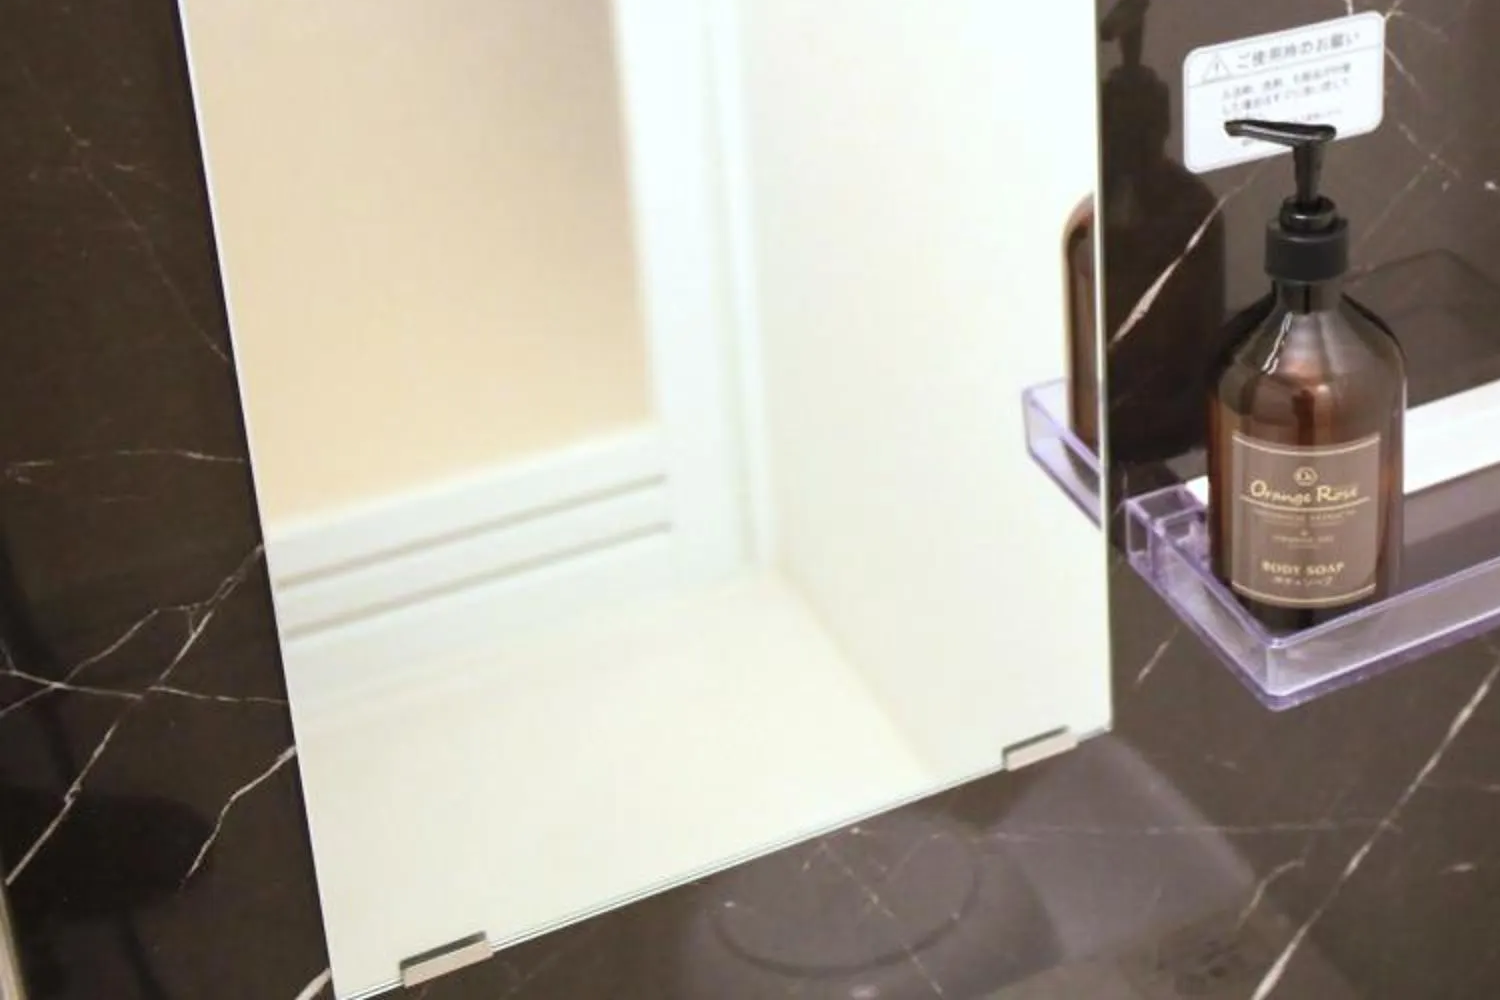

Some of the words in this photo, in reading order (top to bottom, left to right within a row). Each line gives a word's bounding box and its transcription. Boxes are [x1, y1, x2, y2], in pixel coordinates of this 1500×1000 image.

[1250, 479, 1312, 505] Orange
[1261, 560, 1301, 575] BODY
[1305, 560, 1345, 577] SOAP
